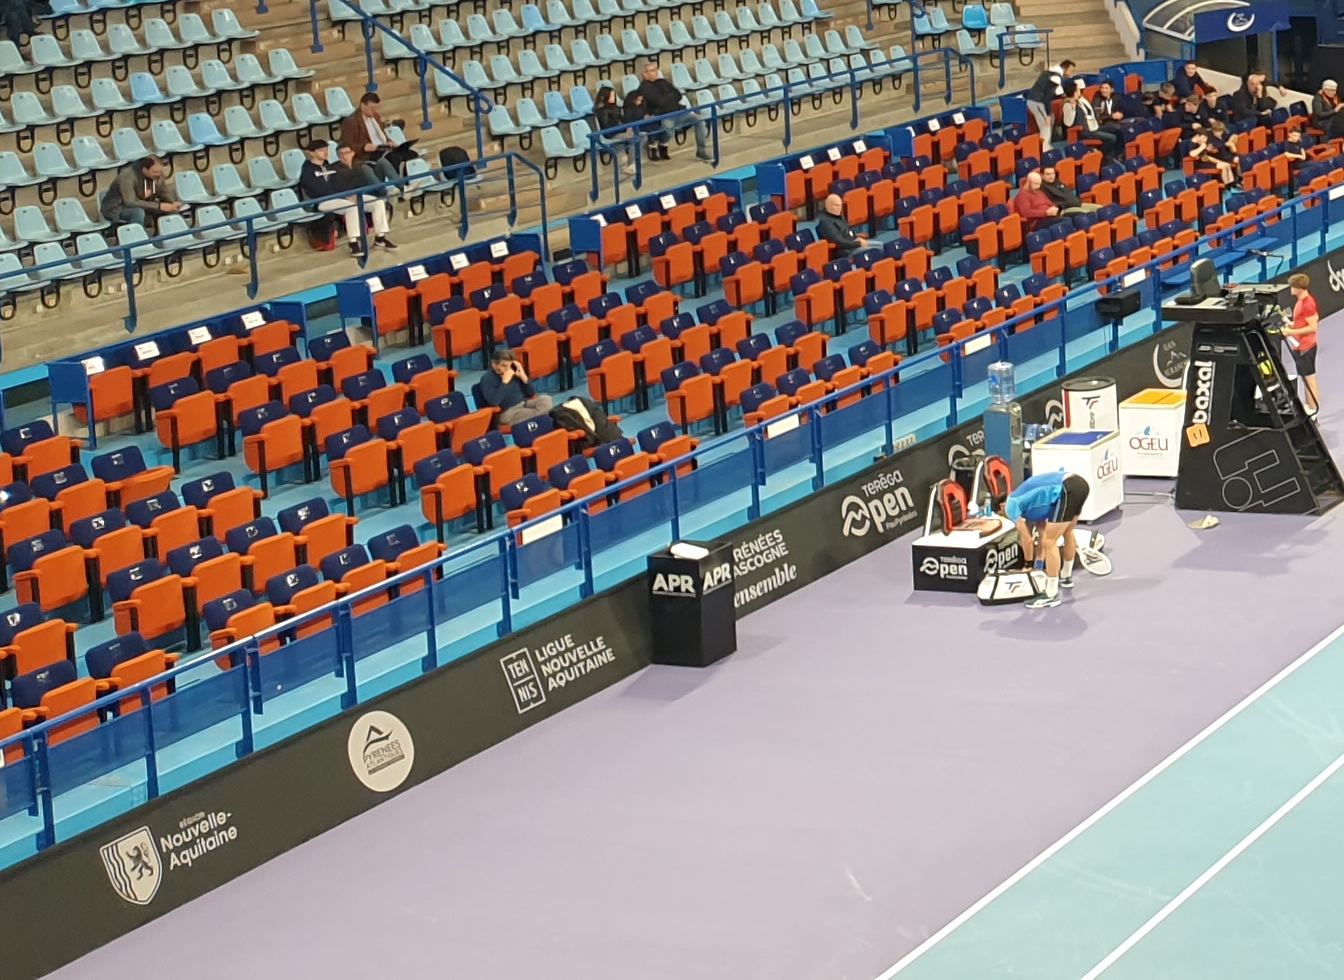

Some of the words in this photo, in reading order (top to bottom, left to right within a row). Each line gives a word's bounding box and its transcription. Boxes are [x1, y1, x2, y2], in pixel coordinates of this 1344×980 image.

[1192, 360, 1213, 425] baxal
[1129, 437, 1169, 452] OGEU
[1096, 457, 1119, 480] OGEU
[841, 485, 915, 538] Open
[733, 529, 784, 563] RÉNÉES
[733, 542, 790, 580] ASCOGNE
[652, 572, 696, 594] APR
[702, 561, 733, 593] APR
[919, 557, 968, 580] Open
[733, 563, 798, 609] ensemble
[534, 633, 576, 663] LIGUE
[540, 635, 607, 678] NOUVELLE
[507, 658, 531, 680] TEN
[548, 647, 617, 692] AQUITAINE
[517, 681, 539, 704] NIS
[159, 811, 233, 853] Nouvelle-
[169, 825, 239, 871] Aquitaine
